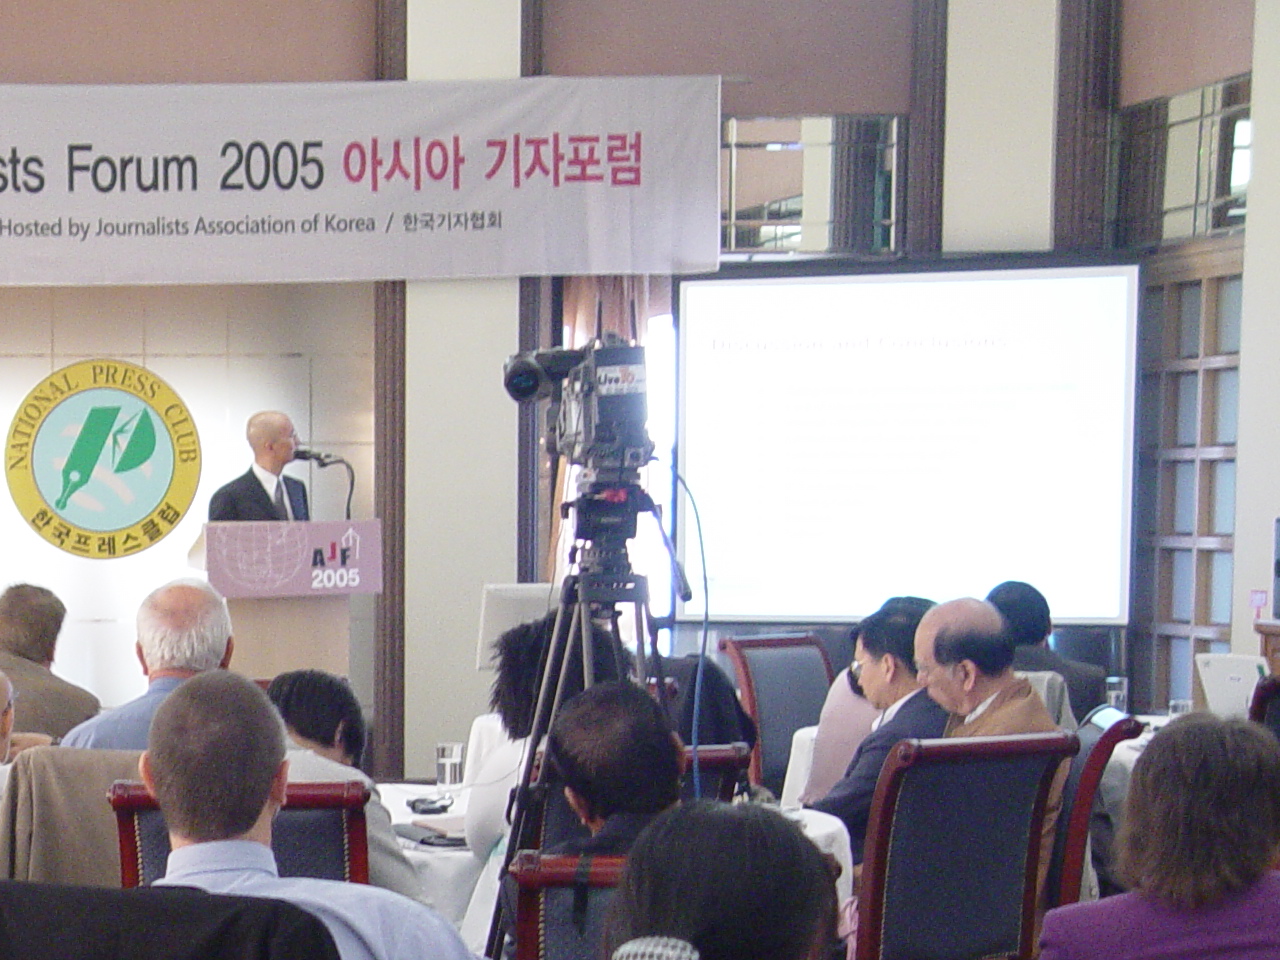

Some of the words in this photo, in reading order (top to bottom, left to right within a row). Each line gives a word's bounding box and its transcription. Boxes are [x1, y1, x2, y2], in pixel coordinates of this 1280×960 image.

[67, 143, 198, 193] Forum
[220, 140, 324, 192] 2005
[343, 135, 466, 192] 아시아
[485, 131, 642, 188] 기자포럼
[68, 217, 91, 241] by
[95, 216, 189, 237] Journalists
[193, 214, 296, 236] Association
[300, 213, 320, 234] of
[324, 214, 376, 233] Korea
[403, 210, 502, 232] 한국기자협회
[8, 372, 80, 471] NATIONAL
[91, 363, 162, 399] PRESS
[163, 402, 198, 464] CLUB
[30, 501, 182, 556] 한국프레스클럽
[311, 541, 351, 568] AJF
[311, 567, 360, 590] 2005
